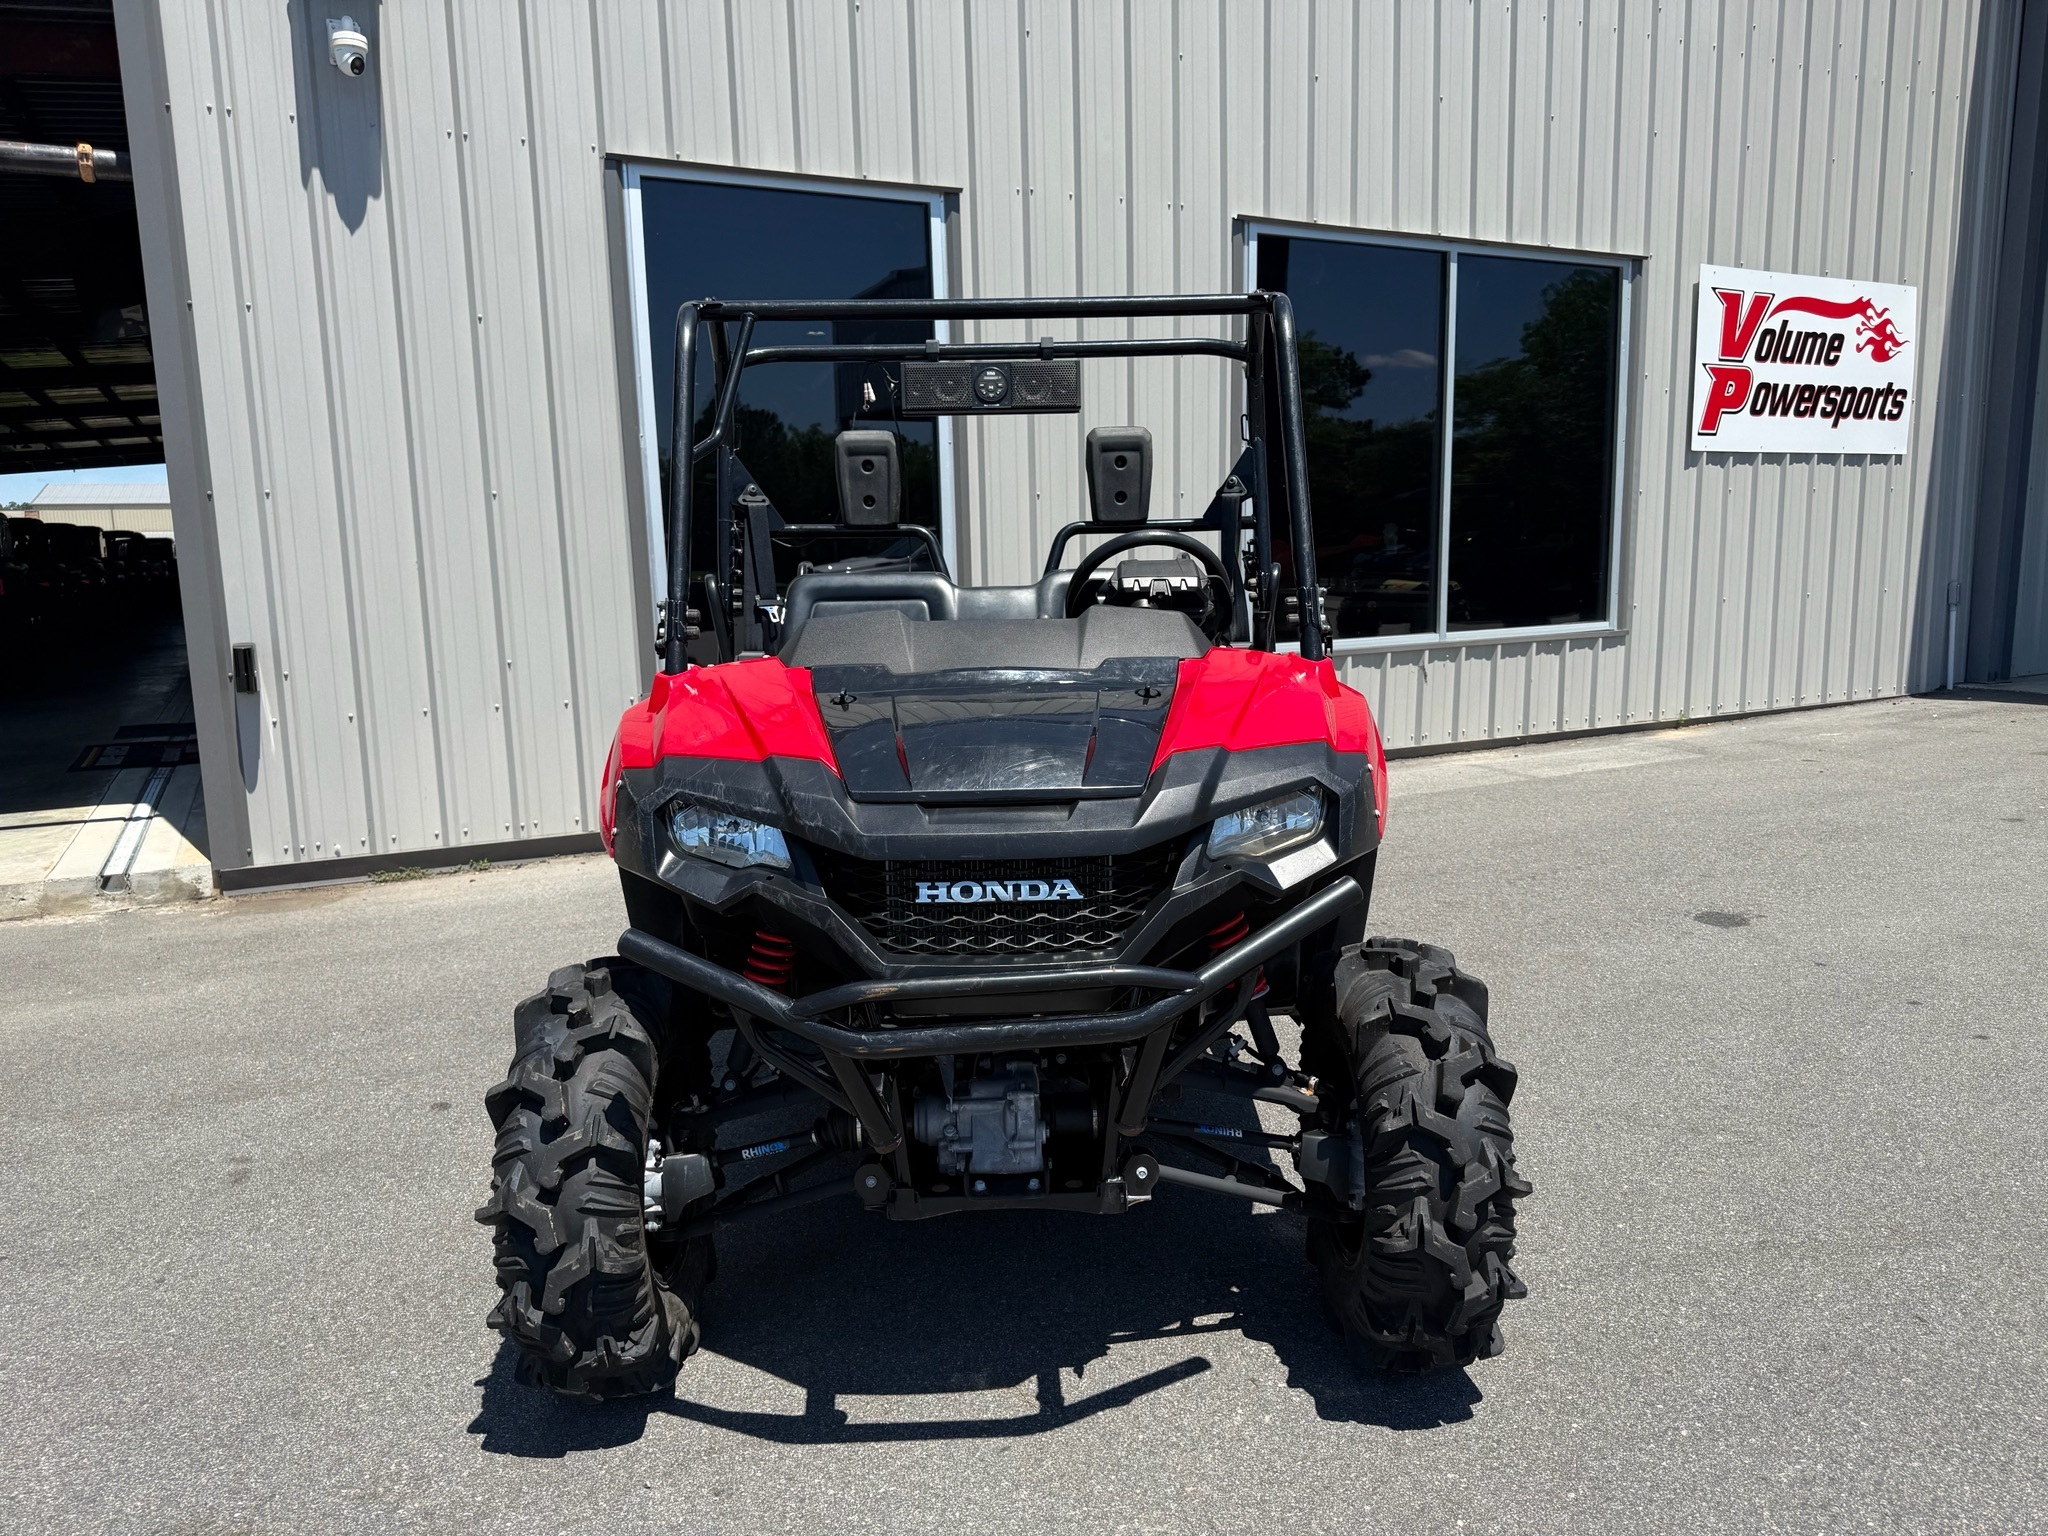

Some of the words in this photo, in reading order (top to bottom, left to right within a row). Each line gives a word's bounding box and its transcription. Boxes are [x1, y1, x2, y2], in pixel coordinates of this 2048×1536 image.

[1711, 286, 1845, 367] Volume
[1697, 363, 1907, 436] Powersports
[915, 879, 1084, 903] HONDA
[741, 1142, 778, 1159] RHINO
